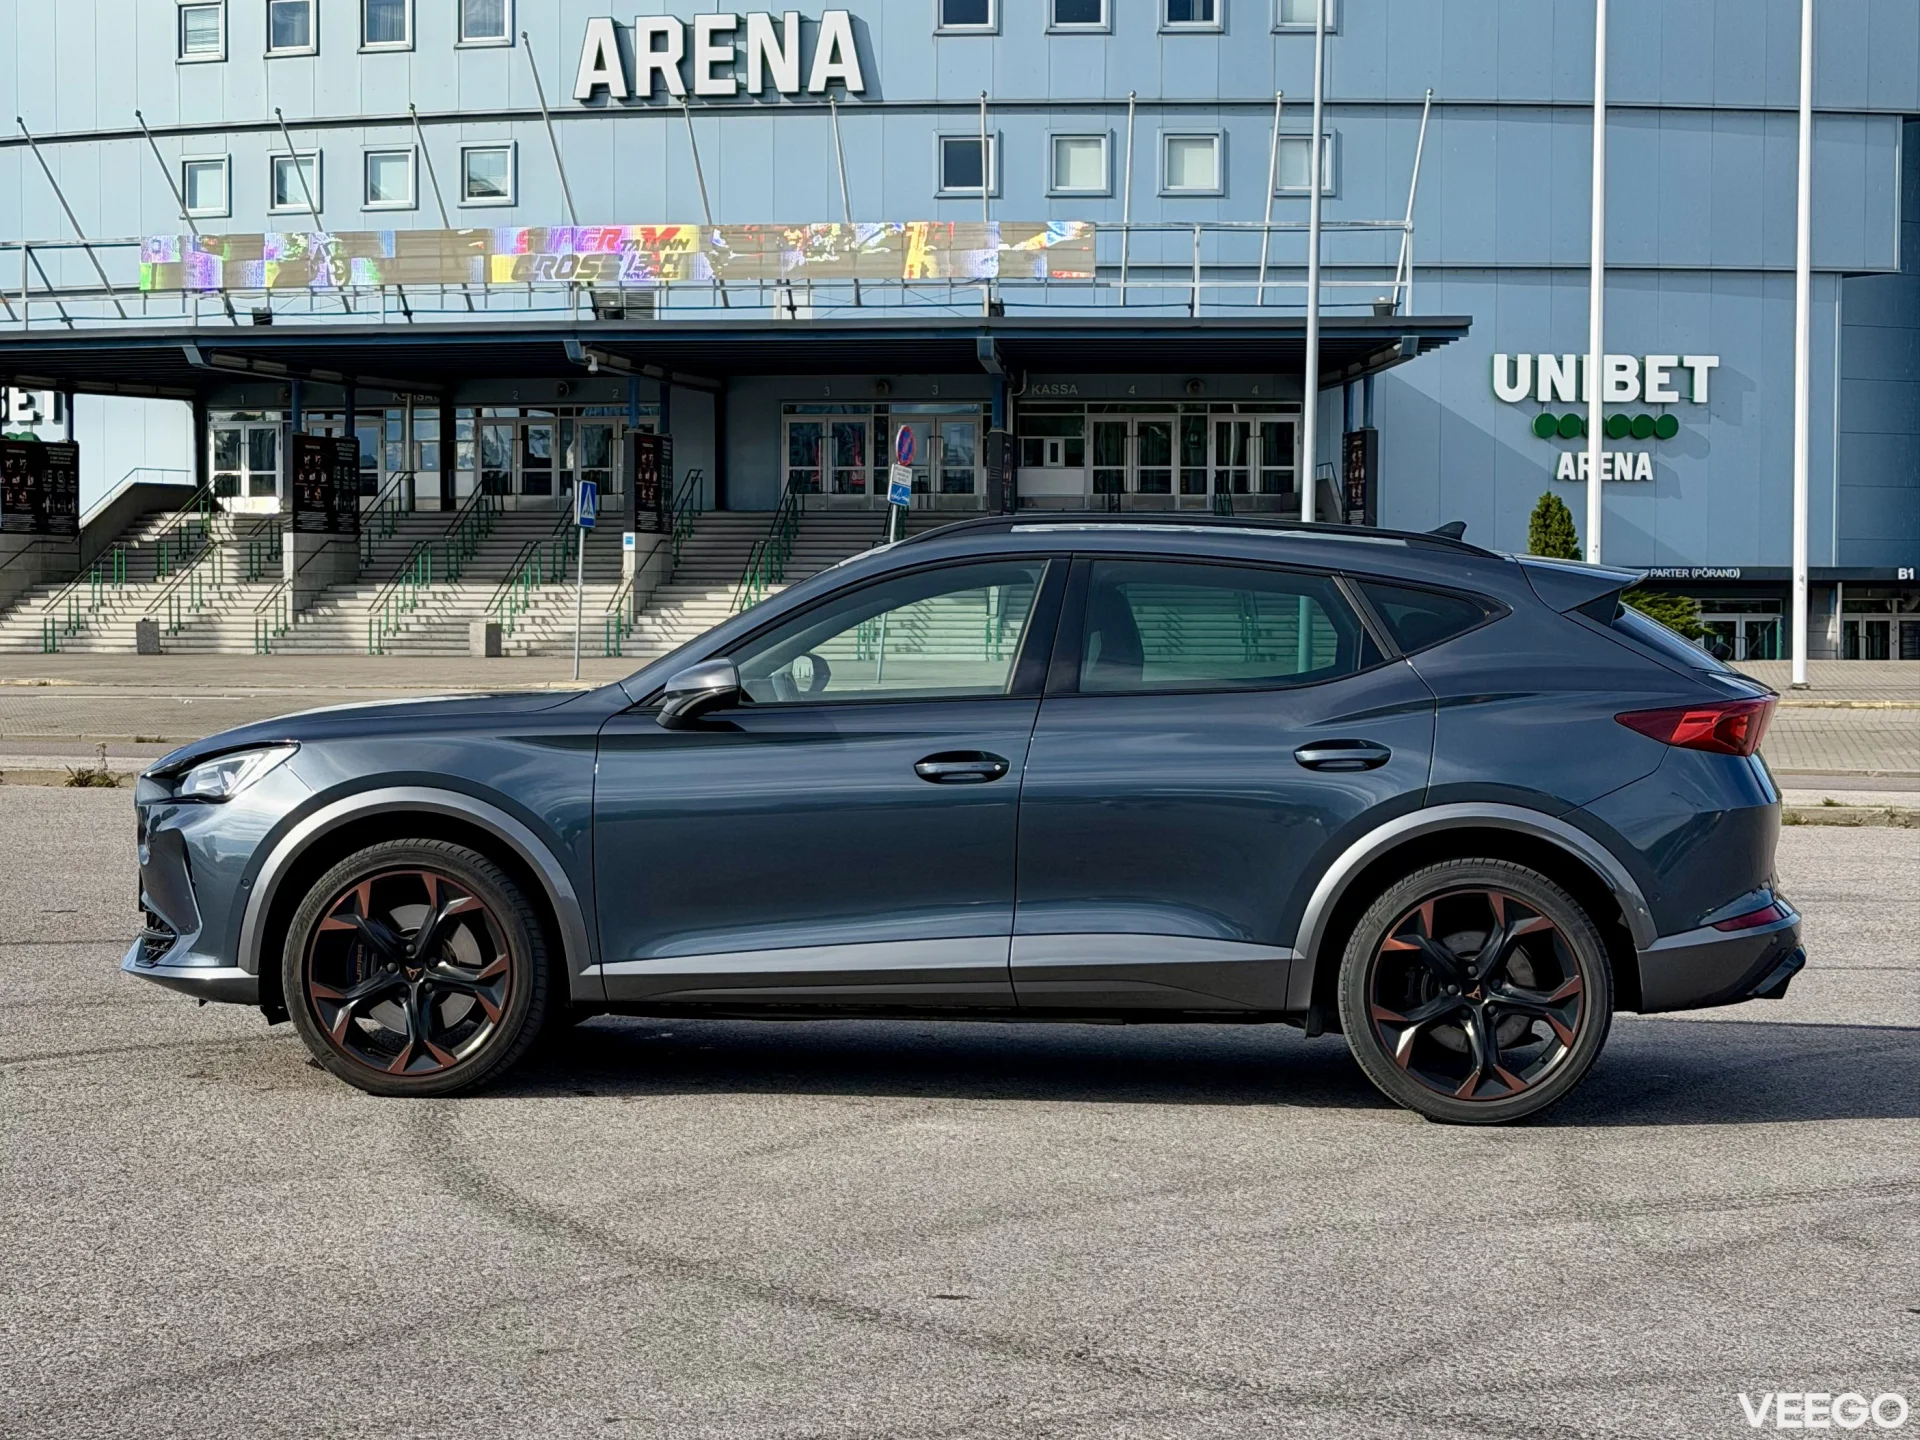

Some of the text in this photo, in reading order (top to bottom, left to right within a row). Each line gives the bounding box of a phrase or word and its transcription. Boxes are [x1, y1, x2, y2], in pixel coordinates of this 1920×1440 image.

[573, 10, 865, 99] ARENA
[510, 253, 621, 281] CROSS
[1493, 354, 1719, 403] UNIBET
[612, 389, 619, 399] 2
[824, 386, 830, 397] 3
[932, 385, 939, 395] 3
[1031, 384, 1078, 395] KASSA
[1128, 385, 1136, 395] 4
[1251, 385, 1259, 395] 4
[512, 391, 519, 400] 2
[1556, 451, 1654, 480] ARENA
[1650, 568, 1690, 578] PARTER
[1898, 567, 1914, 580] B1
